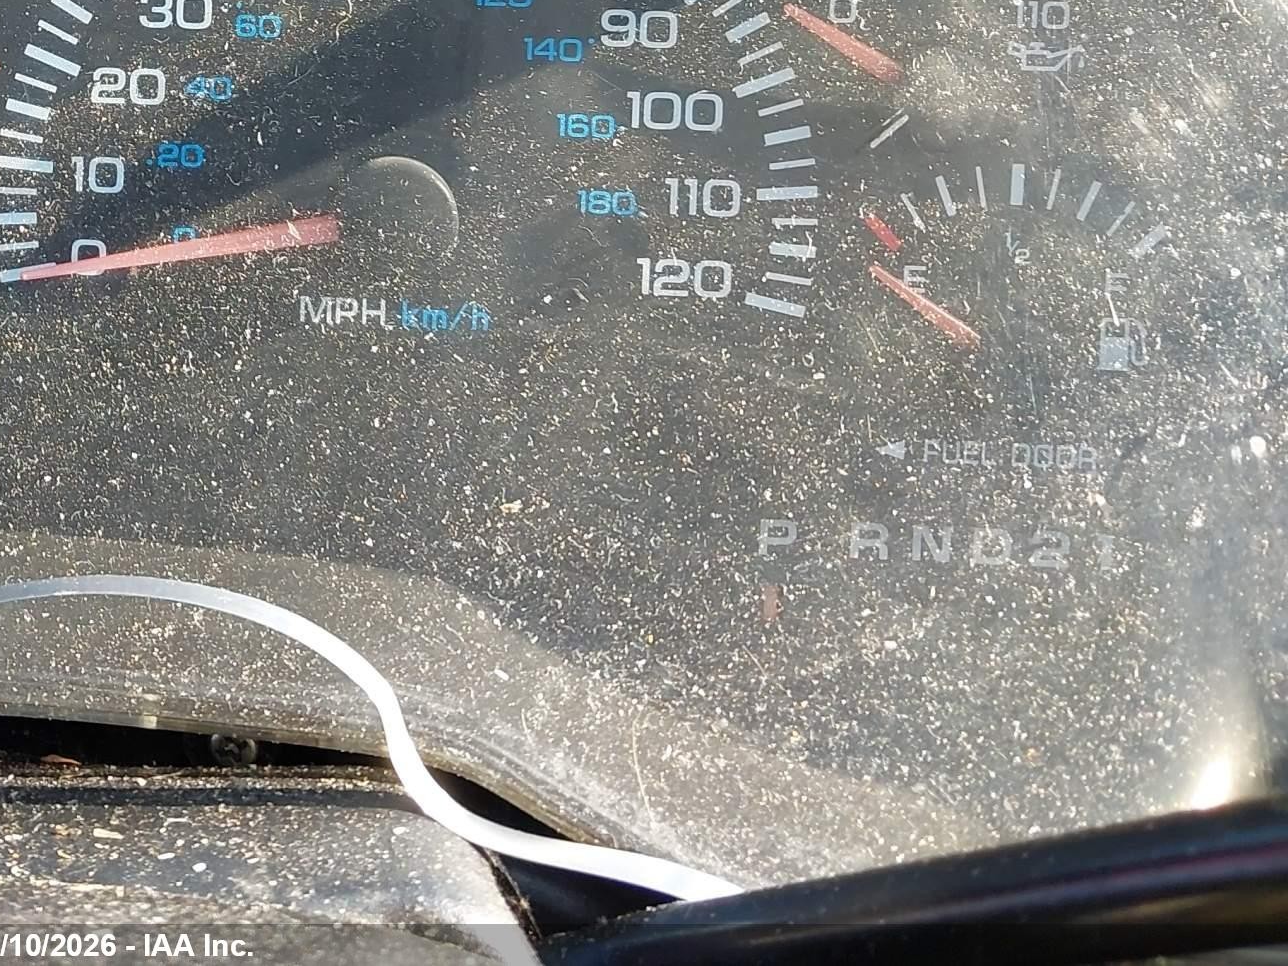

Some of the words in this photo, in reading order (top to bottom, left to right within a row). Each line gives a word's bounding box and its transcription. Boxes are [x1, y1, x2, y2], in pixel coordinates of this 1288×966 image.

[235, 15, 283, 39] 60
[600, 9, 678, 49] 90
[1015, 1, 1070, 30] 110
[524, 38, 583, 63] 140
[90, 67, 166, 106] 20
[557, 114, 615, 139] 160
[626, 91, 724, 131] 100
[157, 143, 205, 169] 20
[73, 156, 125, 194] 10
[665, 177, 742, 217] 110
[71, 239, 107, 276] 0
[636, 258, 732, 298] 120
[904, 265, 927, 294] E
[299, 295, 387, 326] MPH
[401, 298, 489, 332] km/h
[922, 438, 994, 466] FUEL
[1012, 441, 1098, 470] DOOR
[759, 518, 797, 555] P
[849, 522, 889, 560] R
[912, 524, 952, 562] N
